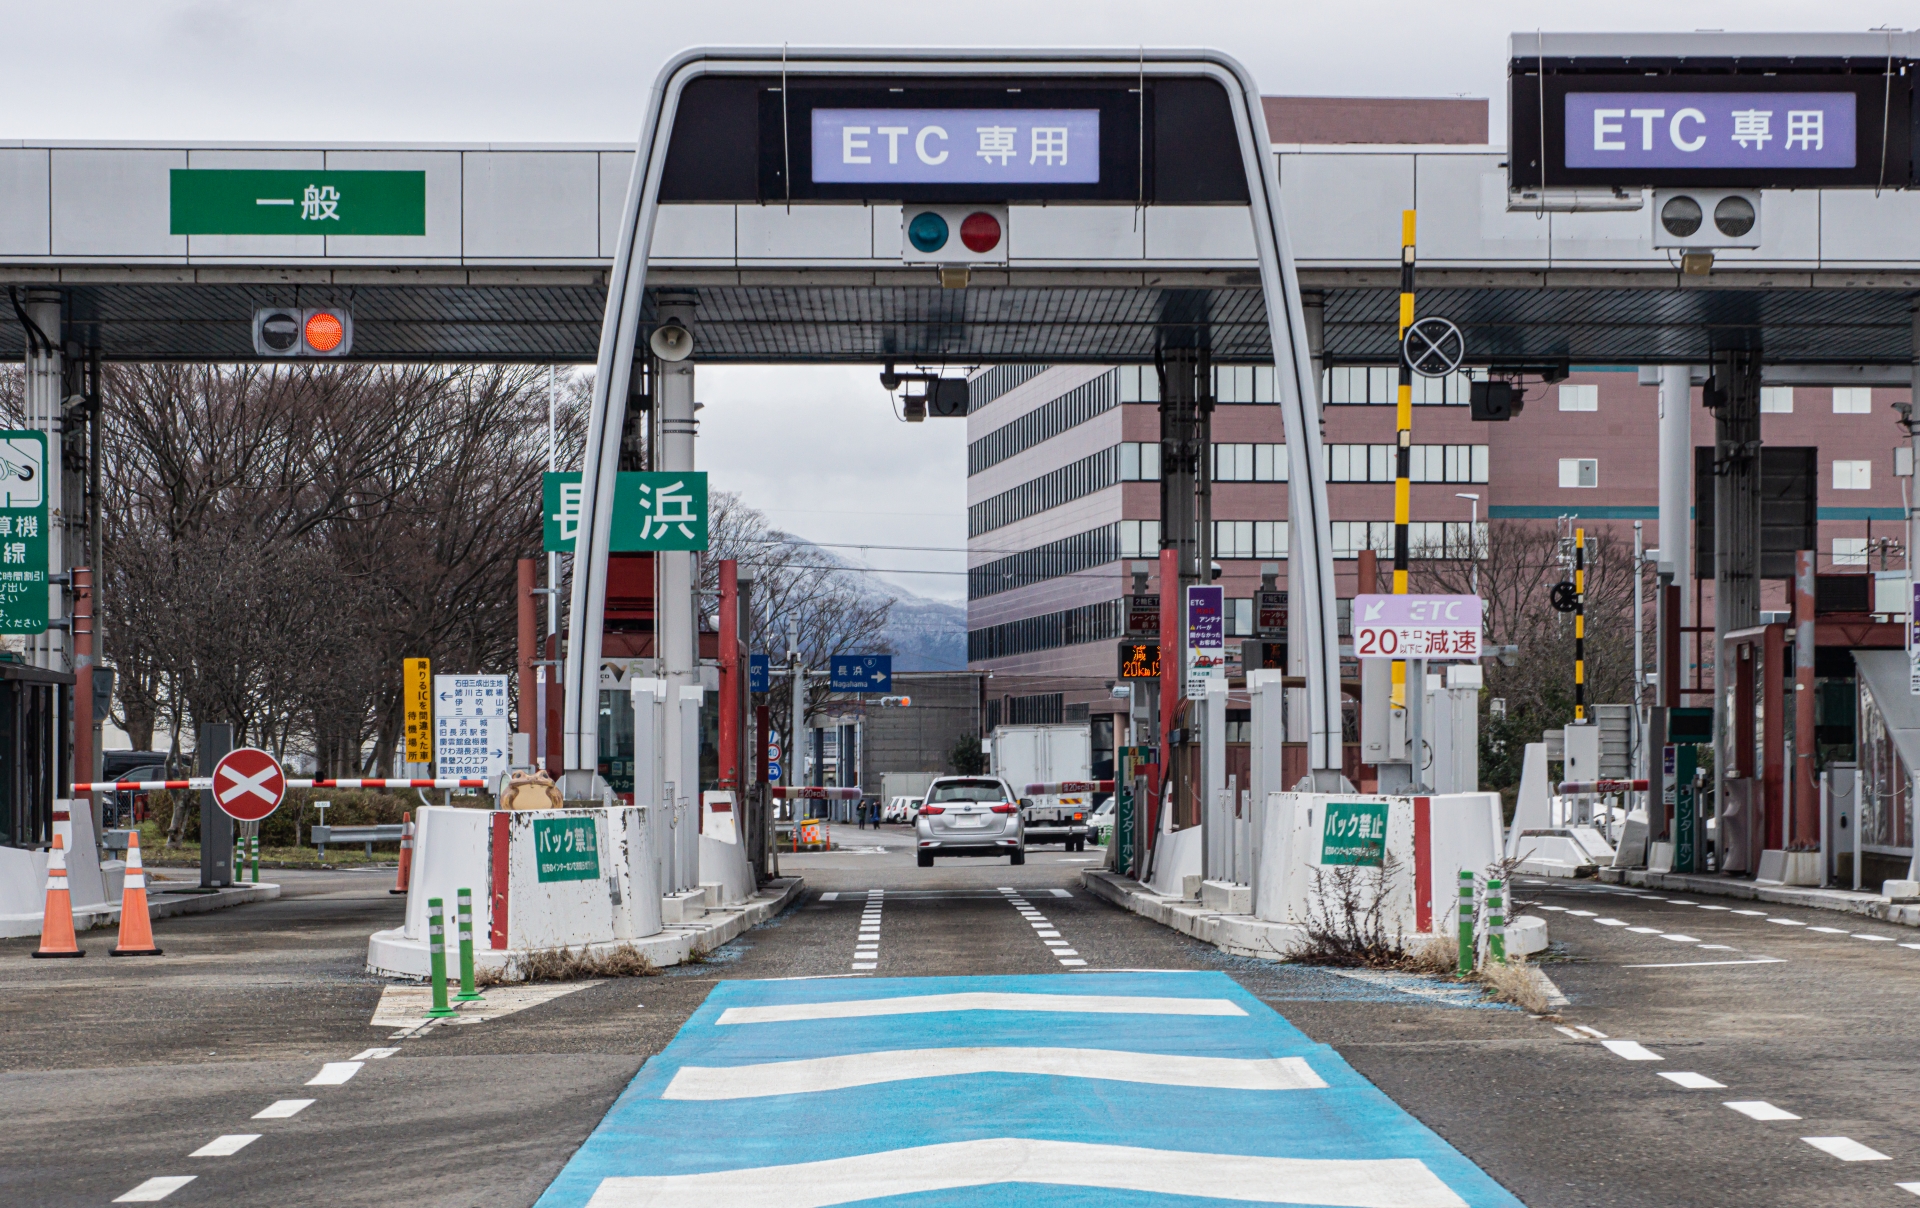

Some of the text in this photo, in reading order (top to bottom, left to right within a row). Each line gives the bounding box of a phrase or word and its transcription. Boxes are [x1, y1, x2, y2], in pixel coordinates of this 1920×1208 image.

[1593, 107, 1824, 152] ETC 専用
[842, 125, 1069, 166] ETC 専用
[256, 184, 341, 221] 一般
[3, 542, 26, 564] 線
[0, 571, 44, 581] 時間割引
[1135, 597, 1160, 605] 2輪ET
[1410, 600, 1462, 621] ETC
[1359, 628, 1477, 655] 20 キロ 減速
[1399, 643, 1423, 654] 以下に
[867, 658, 874, 666] 8
[838, 665, 863, 676] 長浜
[455, 679, 503, 688] 石田三成出生地
[832, 680, 868, 689] Nagahama
[418, 660, 429, 760] 降りるICを間違えた車
[454, 698, 504, 706] 伊吹山
[455, 707, 504, 716] 三島池
[439, 719, 488, 727] 長浜城
[407, 711, 418, 760] 待機場所
[439, 747, 488, 755] びわ湖長浜港
[440, 756, 488, 765] 黒壁スクエア
[1122, 798, 1134, 866] インターホン
[1326, 811, 1384, 839] バック禁止
[1680, 797, 1692, 866] インターホン
[539, 826, 596, 853] バック禁止
